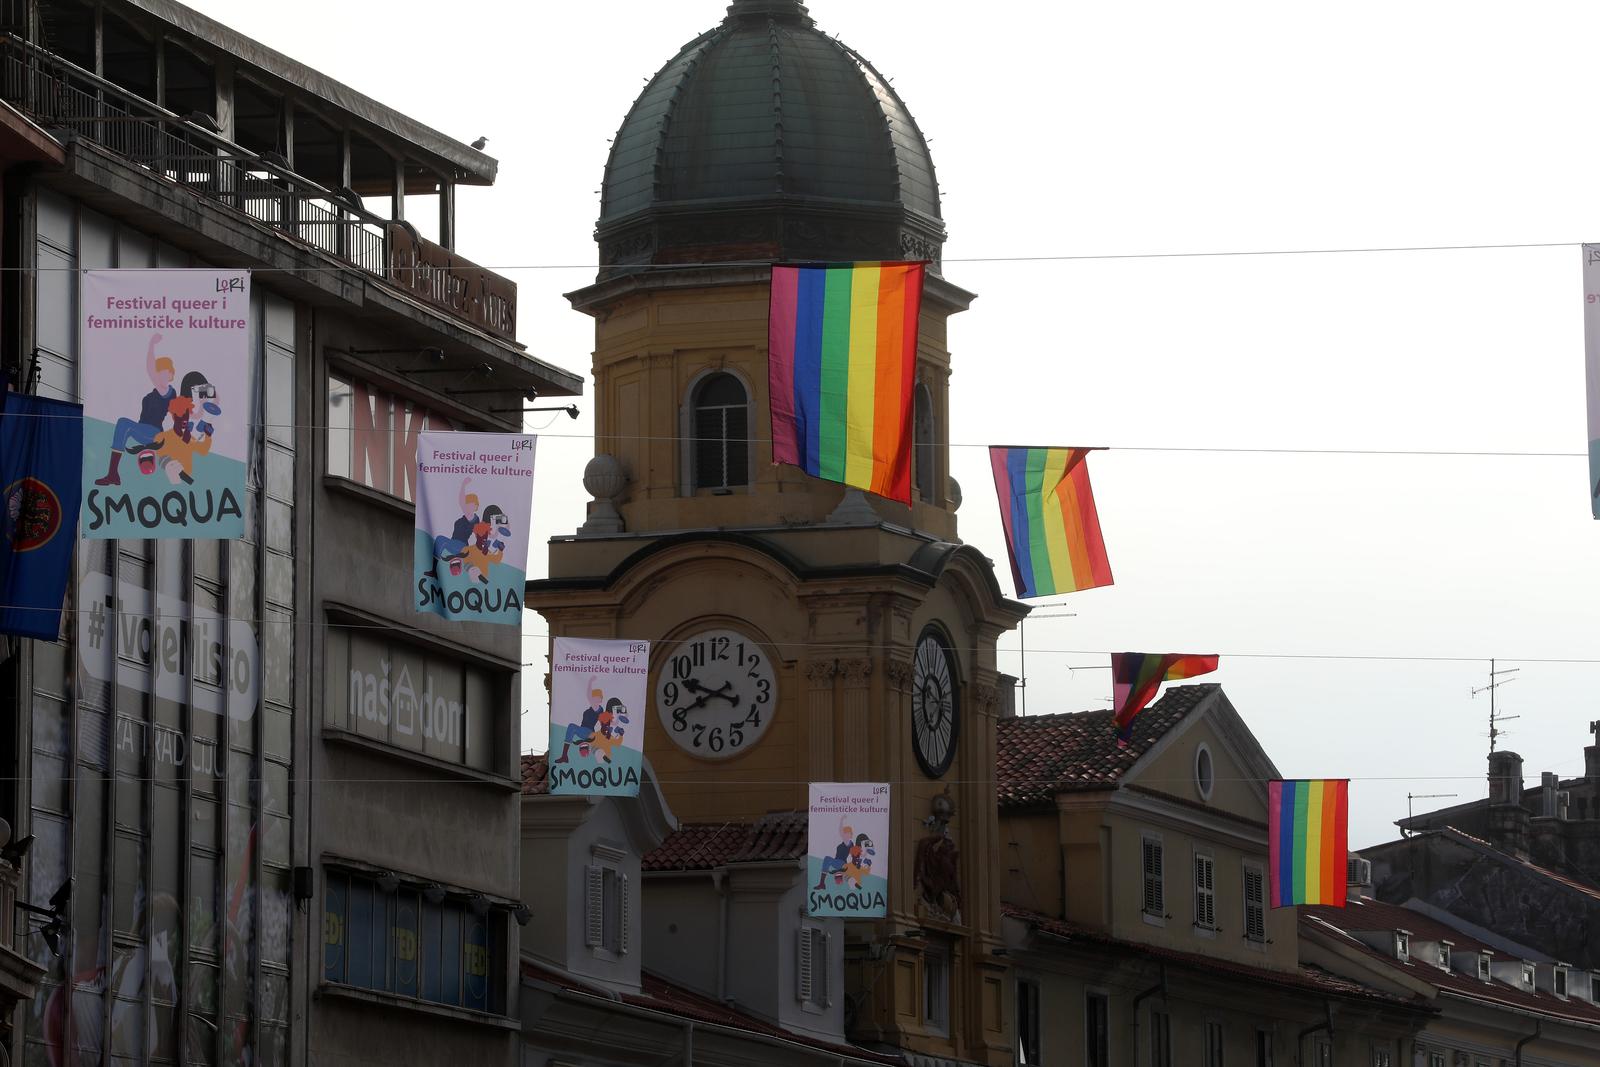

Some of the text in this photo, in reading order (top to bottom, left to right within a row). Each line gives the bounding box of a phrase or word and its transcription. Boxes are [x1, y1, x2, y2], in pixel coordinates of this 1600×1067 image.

[106, 296, 227, 313] Festival queer i
[87, 315, 246, 329] feminističke kulture
[433, 450, 519, 463] Festival queer i
[419, 463, 533, 477] feminističke kulture
[87, 487, 242, 530] SMOQUA
[418, 578, 521, 614] SMOQUA
[565, 653, 600, 662] Festival
[603, 656, 630, 664] queer
[690, 642, 705, 667] 11
[709, 637, 730, 661] 12
[736, 643, 744, 667] 1
[554, 664, 647, 674] feminističke kulture
[671, 655, 692, 679] 10
[747, 654, 760, 678] 2
[350, 657, 470, 749] naš dom
[663, 682, 679, 706] 9
[756, 679, 771, 703] 3
[672, 707, 688, 732] 8
[745, 704, 761, 728] 4
[692, 724, 706, 747] 7
[708, 727, 724, 752] 6
[729, 721, 745, 747] 5
[139, 722, 225, 778] TRADCIJU
[550, 765, 638, 790] SMOQUA
[851, 797, 874, 805] queer
[810, 891, 886, 912] SMOQUA
[391, 926, 417, 961] TED
